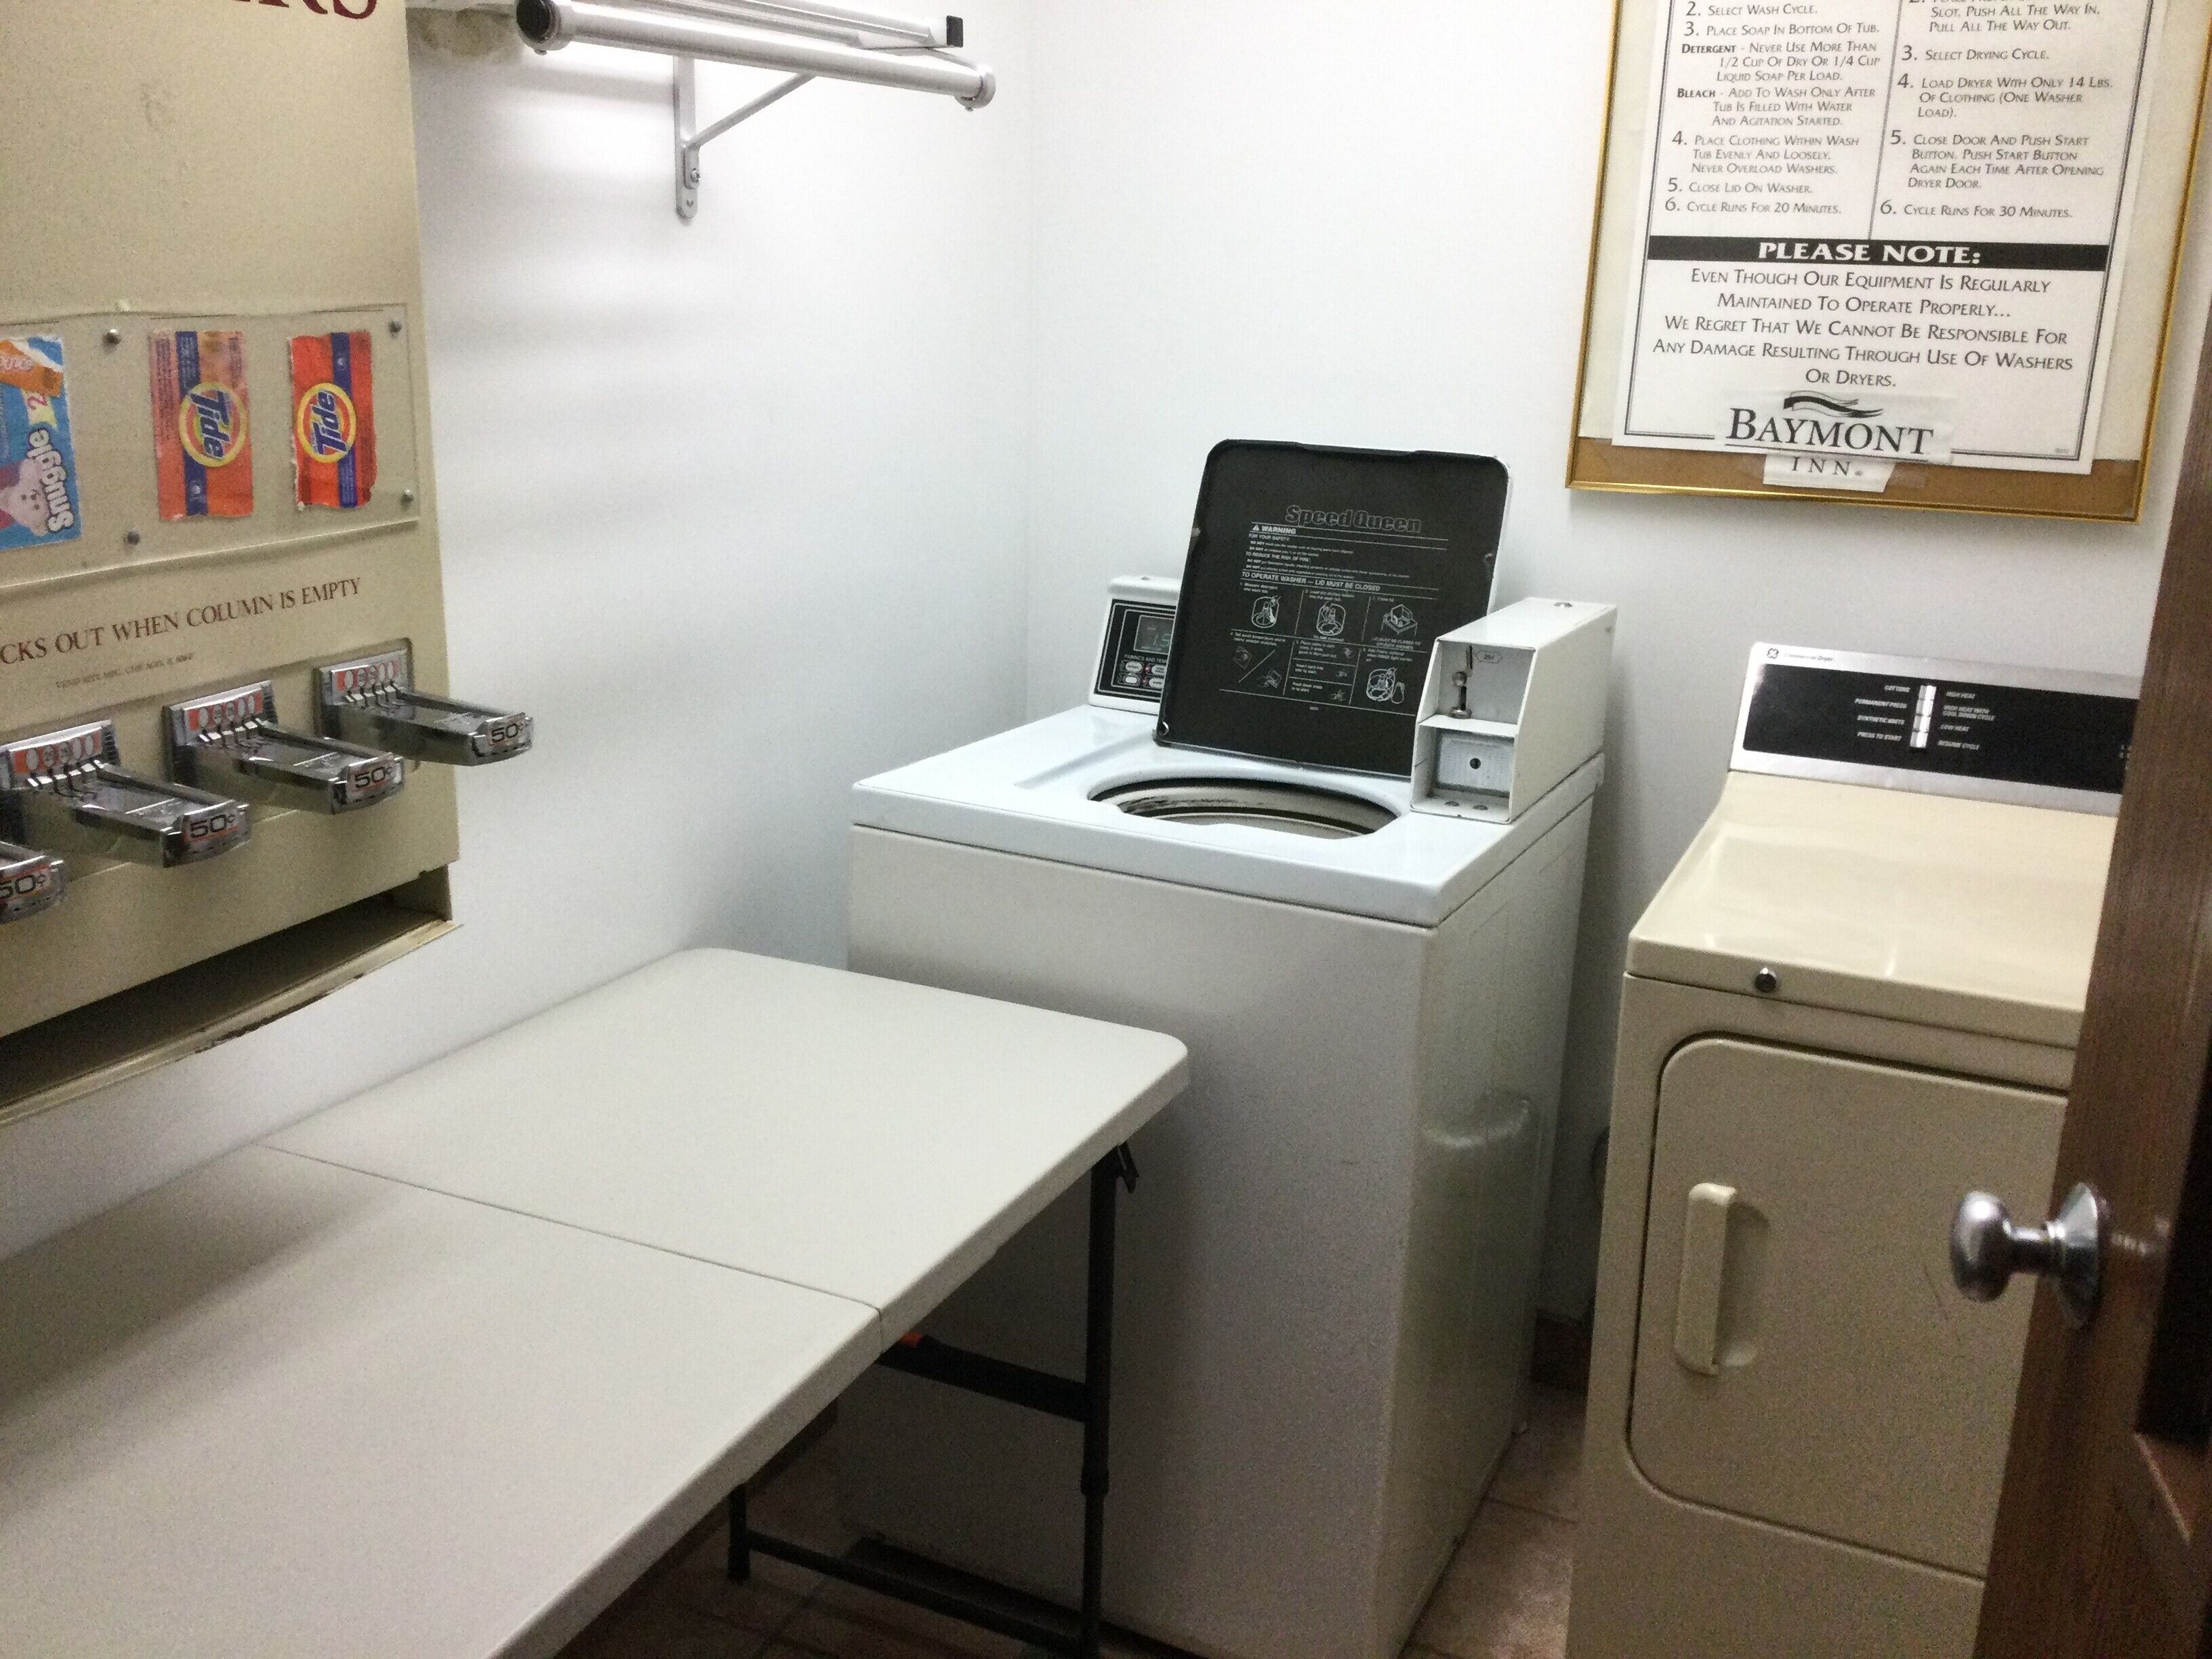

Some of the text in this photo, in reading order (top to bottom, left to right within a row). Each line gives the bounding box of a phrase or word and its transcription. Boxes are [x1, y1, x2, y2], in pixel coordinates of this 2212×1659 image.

[1686, 1, 1818, 16] 2. SELECT WASH CYCLE.
[1931, 3, 2100, 18] SLOT. PUSH ALL THE WAY IN.
[1684, 21, 1880, 36] 3. PLACE SOAP IN BOTTOM OF TUB.
[1681, 41, 1877, 54] DETERGENT NEVER USE MORE THAN
[1902, 45, 2049, 61] 3. SELECT DRYING CYCLE.
[1720, 56, 1881, 67] 1/2 CUP OF DRY OR 1/4 CUP
[1898, 73, 2113, 89] 4. LOAD DRYER WITH ONLY 14 LBS.
[1677, 87, 1875, 98] BLEACH ADD TO WASH ONLY AFTER
[1672, 131, 1860, 146] 4. PLACE CLOTHING WITHIN WASH
[1890, 130, 2089, 146] 5. CLOSE DOOR AND PUSH START
[1668, 178, 1813, 192] 5. CLOSE LID ON WASHER.
[1665, 197, 1841, 213] 6. CYCLE RUNS FOR 20 MINUTES.
[1880, 200, 2072, 218] 6. CYCLE RUNS FOR 30 MINUTES.
[1759, 242, 1981, 264] PLEASE NOTE:
[1692, 268, 2051, 292] EVEN THOUGH OUR EQUIPMENT IS REGULARLY
[1717, 293, 2010, 317] MAINTAINED TO OPERATE PROPERLY...
[1665, 315, 2067, 344] WE REGRET THAT WE CANNOT BE RESPONSIBLE FOR
[1653, 339, 2073, 370] ANY DAMAGE RESULTING THROUGH USE OF WASHERS
[1805, 369, 1896, 387] OR DRYERS.
[189, 390, 230, 460] Tide
[310, 388, 348, 456] Tide
[1725, 408, 1933, 454] BAYMONT
[28, 428, 75, 533] Snuggle
[1286, 505, 1422, 533] Speed Queen
[1261, 525, 1296, 535] WARNING
[1251, 572, 1279, 581] OPERATE
[1281, 575, 1307, 583] WASHER
[1326, 580, 1343, 588] MUST
[1355, 583, 1380, 592] CLOSED
[54, 627, 105, 653] OUT
[112, 611, 179, 641] WHEN
[186, 593, 273, 628] COLUMN
[280, 591, 295, 610] IS
[302, 577, 361, 605] EMPTY
